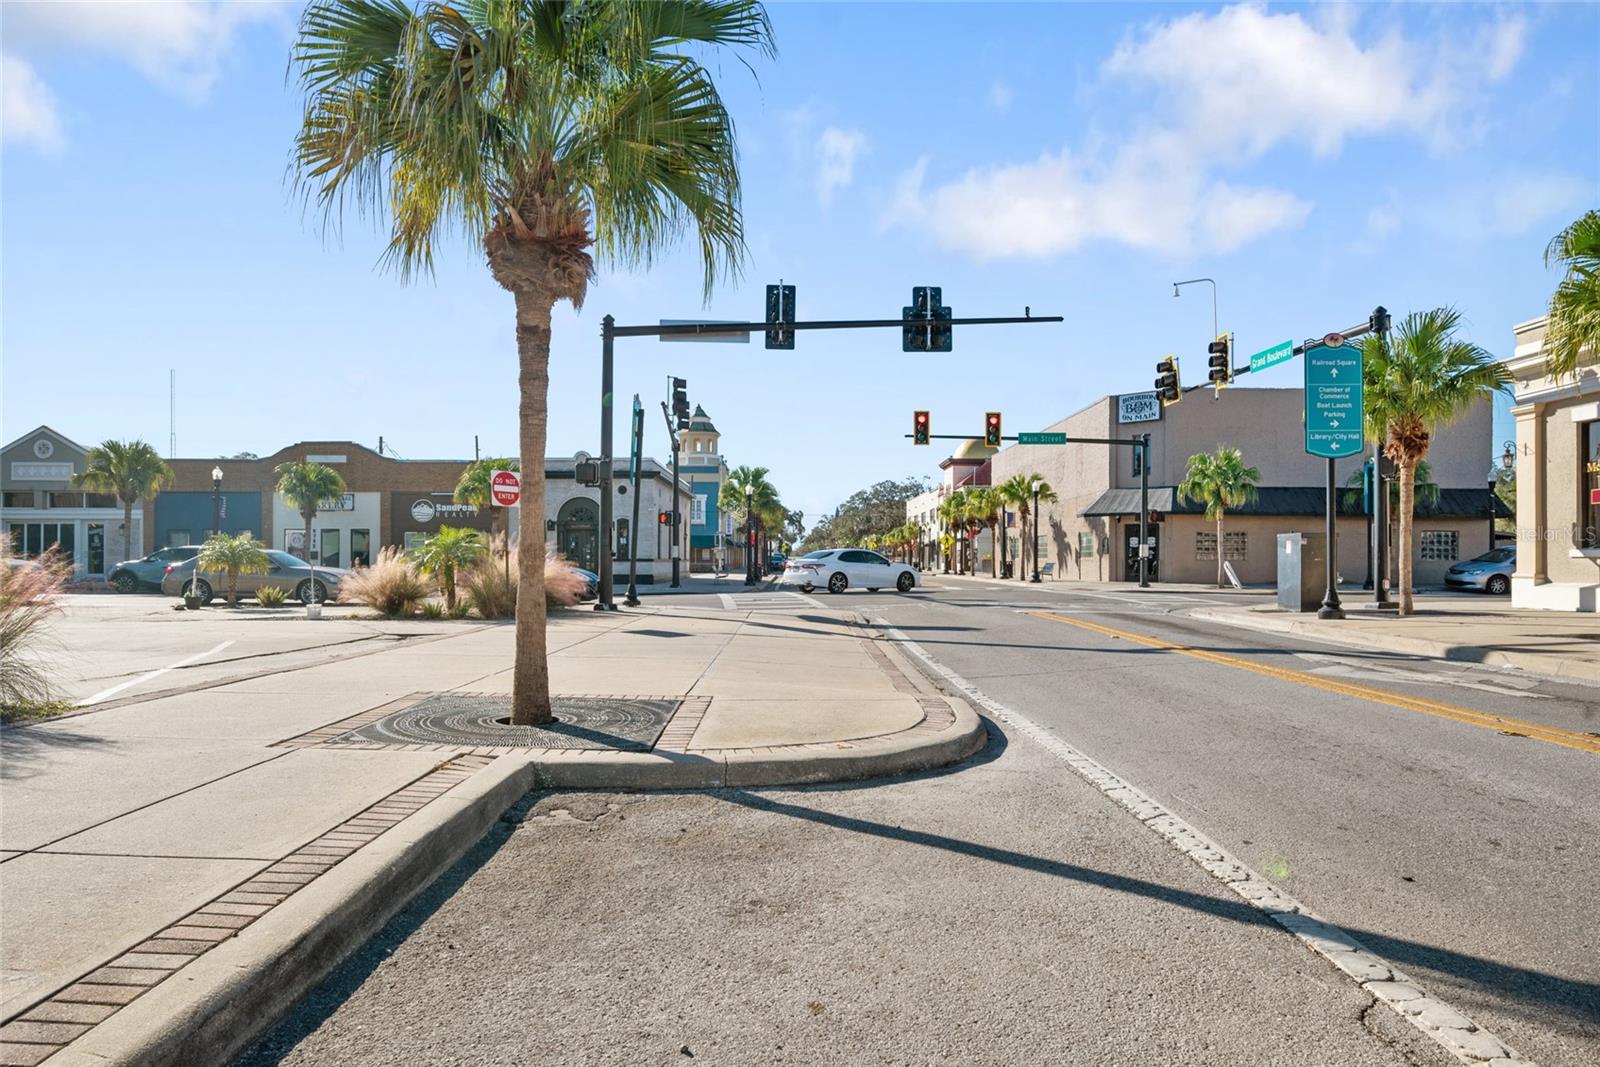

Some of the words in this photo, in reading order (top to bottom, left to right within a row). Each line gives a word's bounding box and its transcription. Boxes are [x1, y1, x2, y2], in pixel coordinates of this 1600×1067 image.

[1252, 355, 1266, 368] Grand
[1267, 344, 1292, 363] Boulevard
[1135, 412, 1156, 420] MAIN
